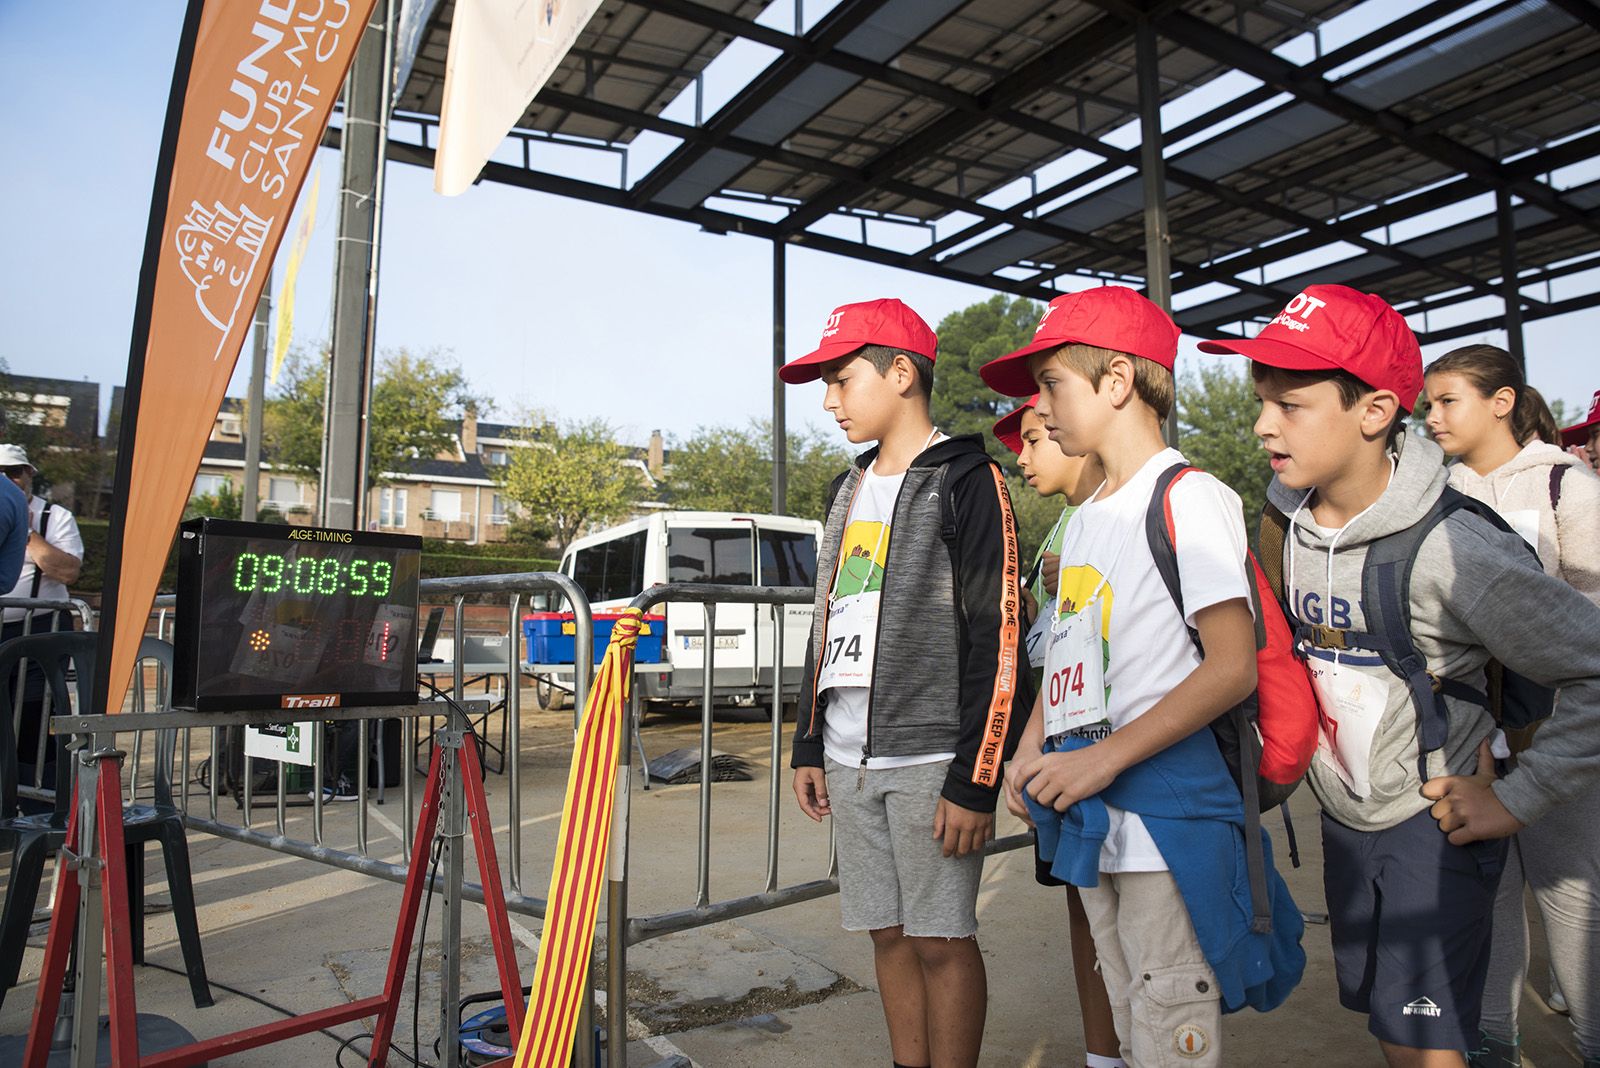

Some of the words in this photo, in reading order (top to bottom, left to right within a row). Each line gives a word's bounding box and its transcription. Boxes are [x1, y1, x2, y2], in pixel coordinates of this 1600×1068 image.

[240, 79, 292, 184] CLUB
[262, 74, 321, 200] SANT
[1004, 506, 1013, 534] YOUR
[1006, 536, 1016, 563] HEAD
[234, 552, 392, 597] 09:08:59
[1005, 565, 1016, 577] IN
[1006, 578, 1016, 598] THE
[1004, 600, 1016, 627] GAME
[999, 646, 1015, 693] TITANIUM
[1049, 661, 1085, 707] 074
[286, 695, 336, 708] Trail
[991, 711, 1006, 738] KEEP
[984, 741, 999, 767] YOUR
